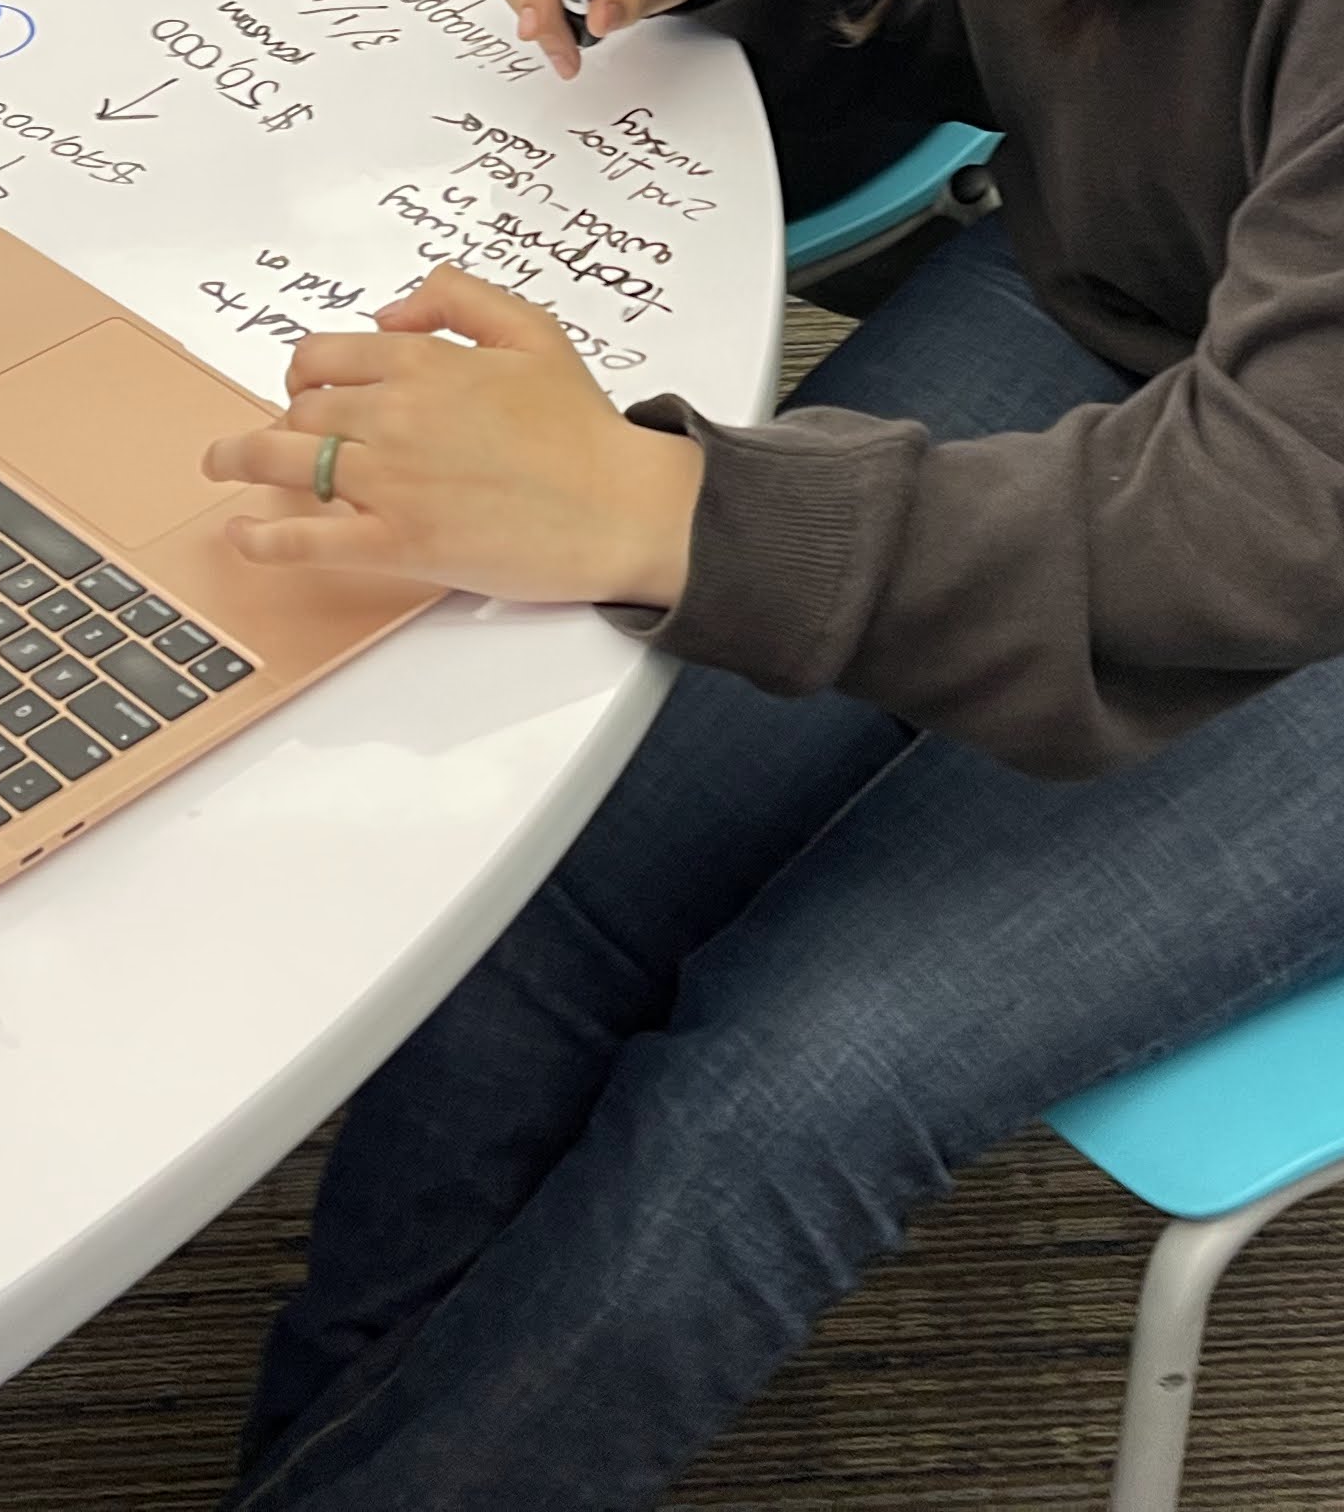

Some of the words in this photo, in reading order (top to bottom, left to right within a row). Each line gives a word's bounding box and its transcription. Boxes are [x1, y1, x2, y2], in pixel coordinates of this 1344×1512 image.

[431, 112, 556, 172] ladder
[567, 127, 657, 181] floor
[626, 181, 719, 222] 2nd
[198, 280, 248, 314] to
